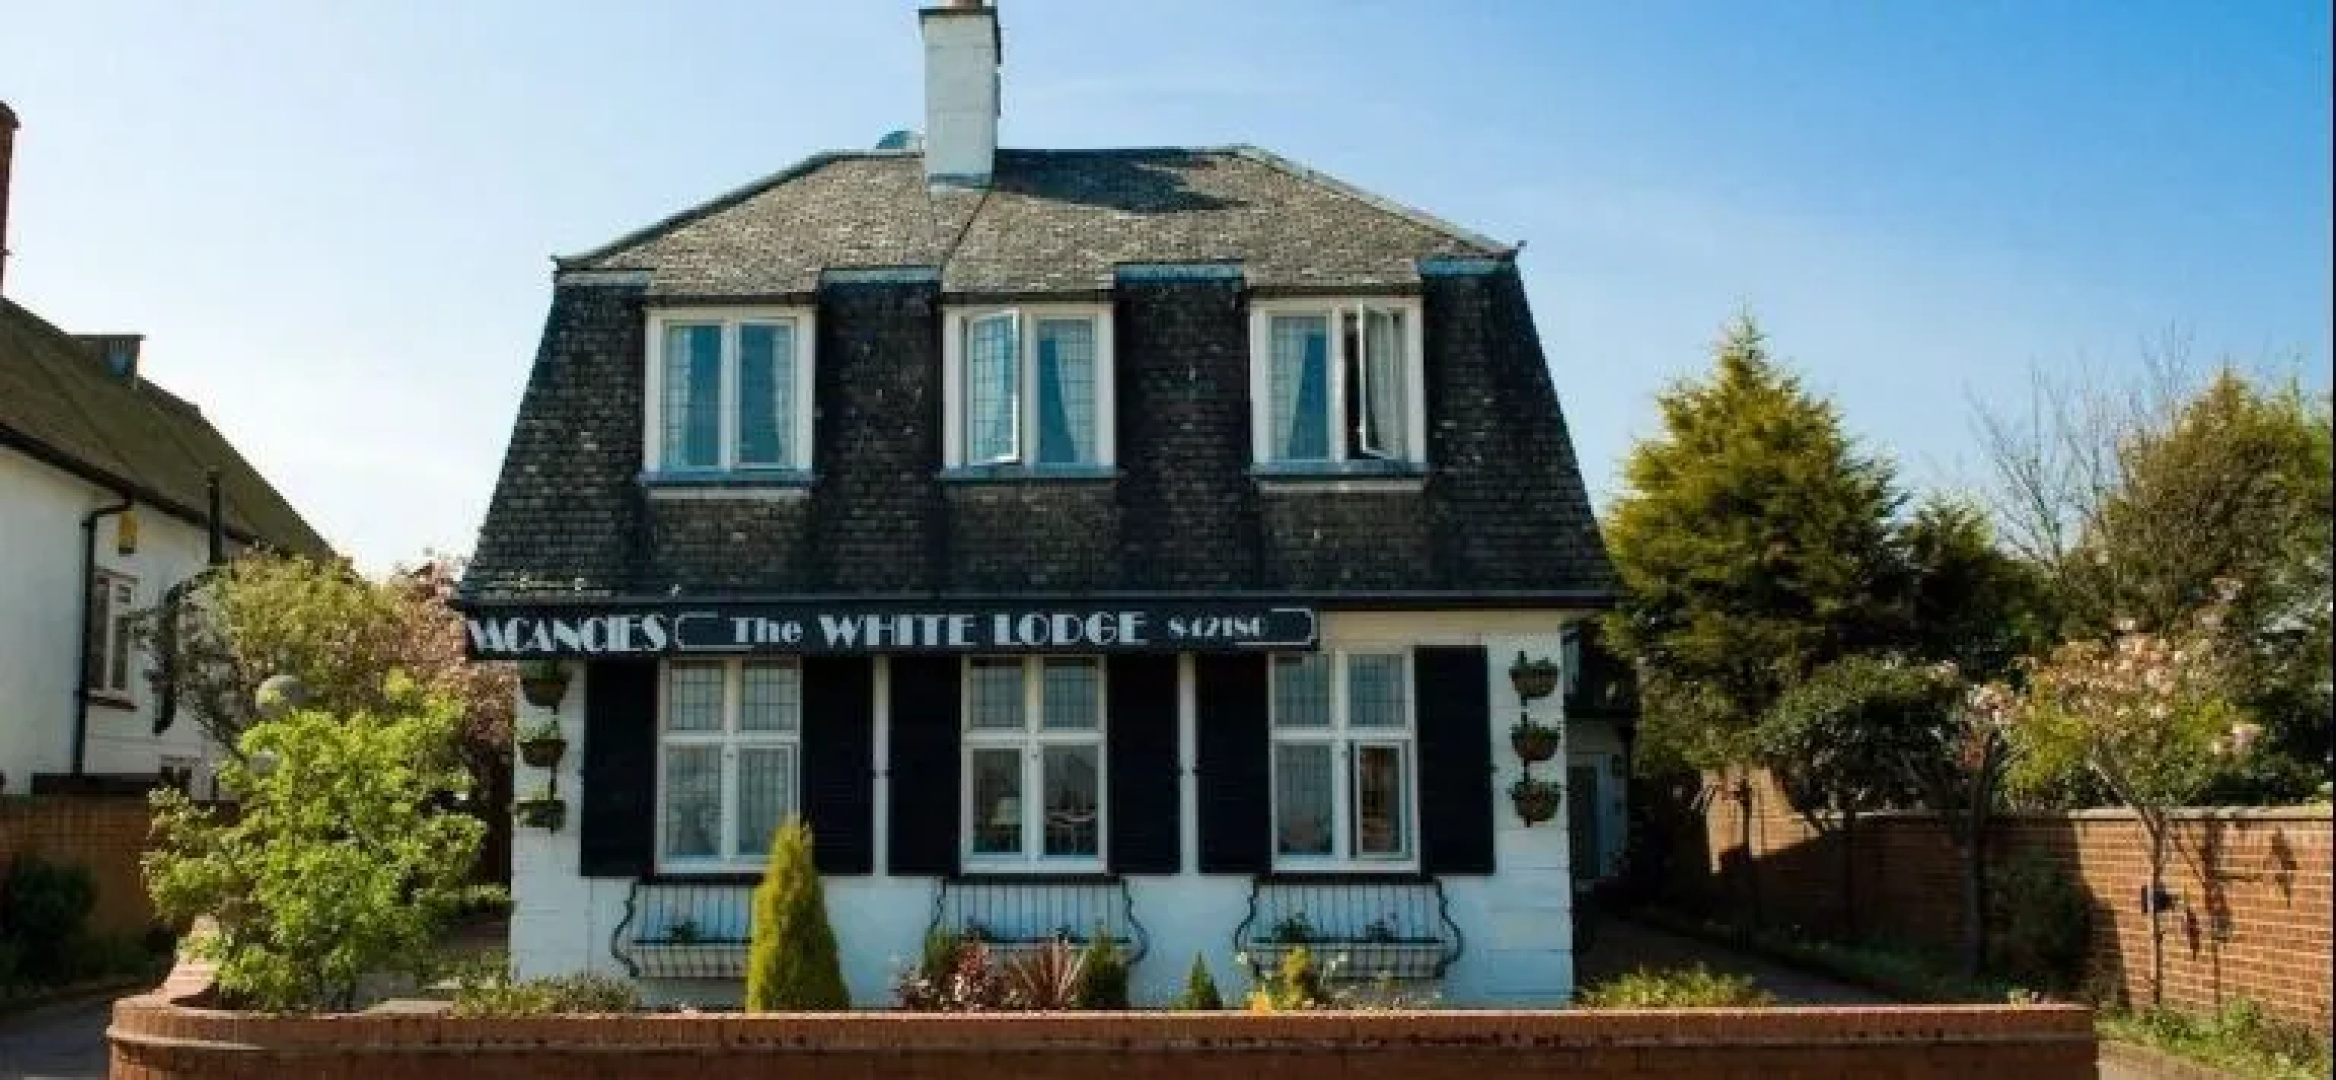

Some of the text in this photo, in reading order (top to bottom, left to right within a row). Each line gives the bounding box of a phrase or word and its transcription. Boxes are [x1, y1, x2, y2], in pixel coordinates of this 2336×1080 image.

[465, 613, 668, 652] VACANCIES
[730, 616, 802, 644] The
[818, 613, 977, 649] WHITE
[993, 611, 1149, 647] LODGE
